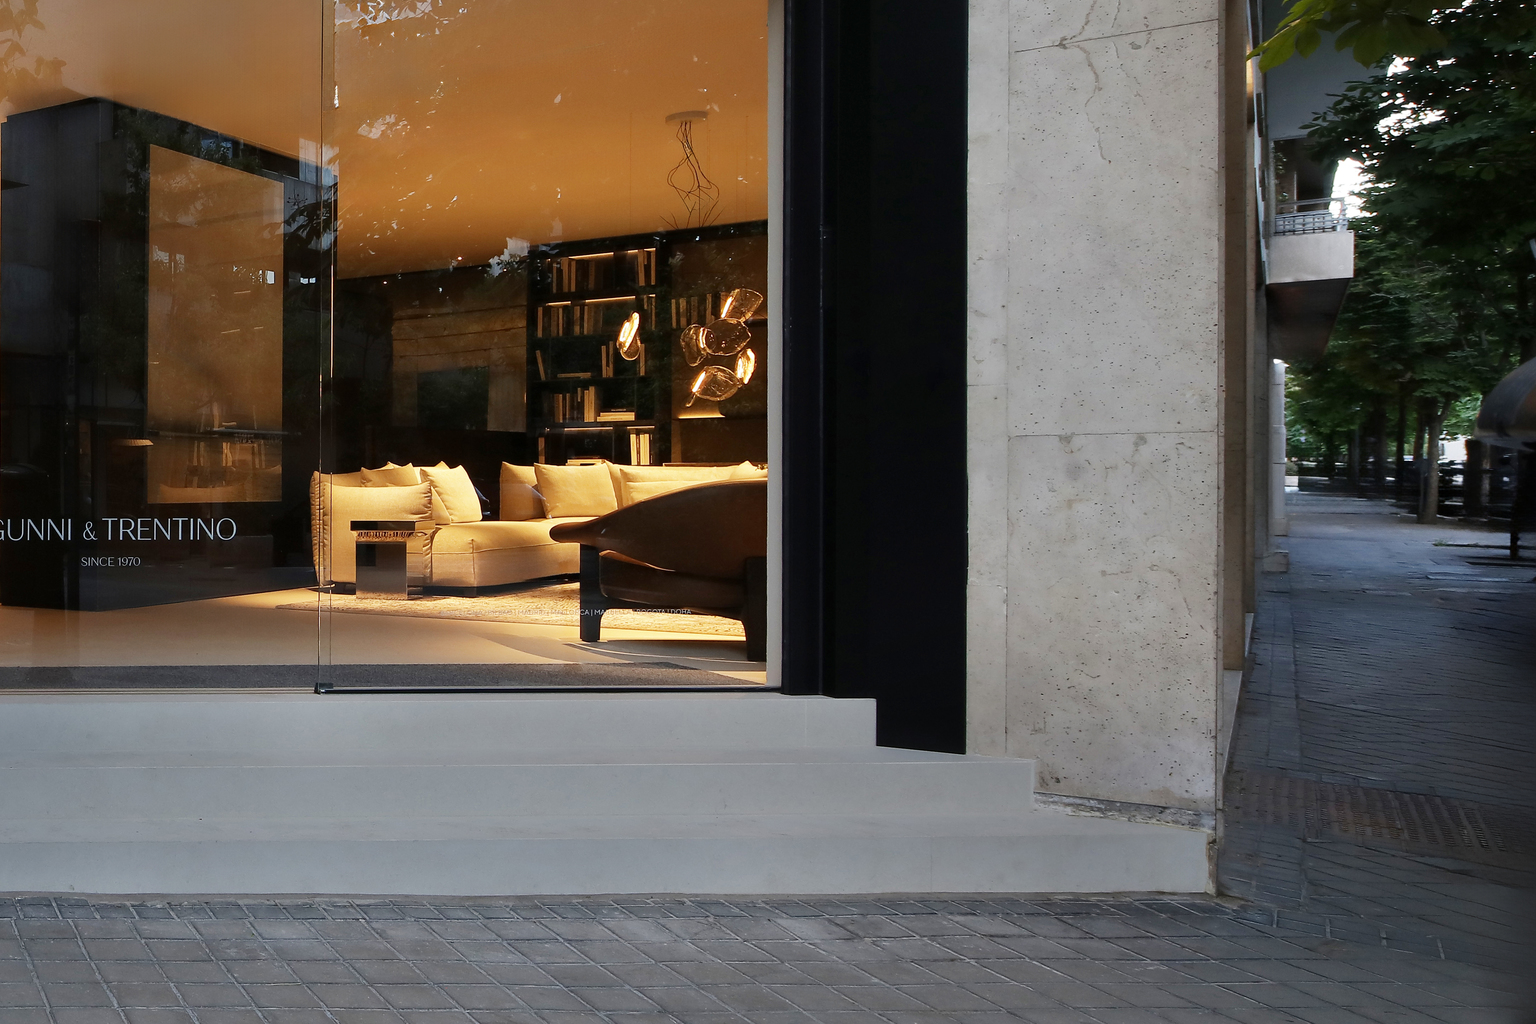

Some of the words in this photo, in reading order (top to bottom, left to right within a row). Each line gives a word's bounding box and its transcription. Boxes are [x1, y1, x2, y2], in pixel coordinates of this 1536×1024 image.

[82, 520, 98, 541] &
[102, 517, 238, 541] TRENTINO
[80, 556, 115, 568] SINCE
[117, 556, 141, 568] 1970
